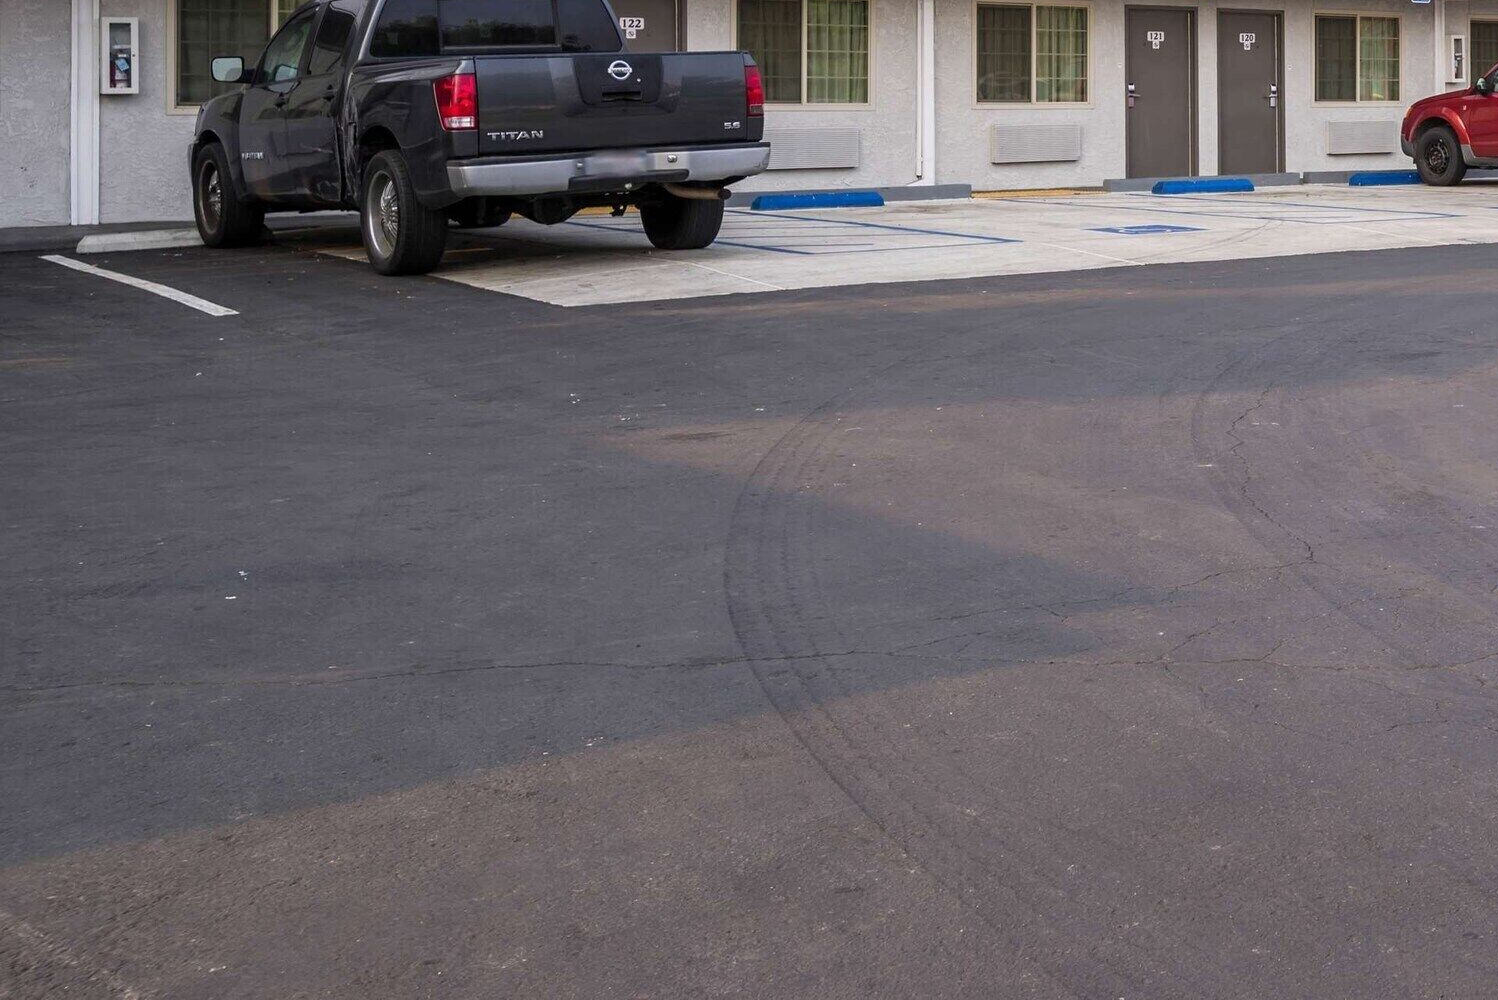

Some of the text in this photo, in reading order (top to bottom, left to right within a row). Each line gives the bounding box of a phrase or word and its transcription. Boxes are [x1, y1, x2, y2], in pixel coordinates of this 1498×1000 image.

[623, 19, 642, 29] 122
[1150, 32, 1162, 40] 121
[1241, 34, 1254, 42] 120
[487, 130, 543, 141] TITAN
